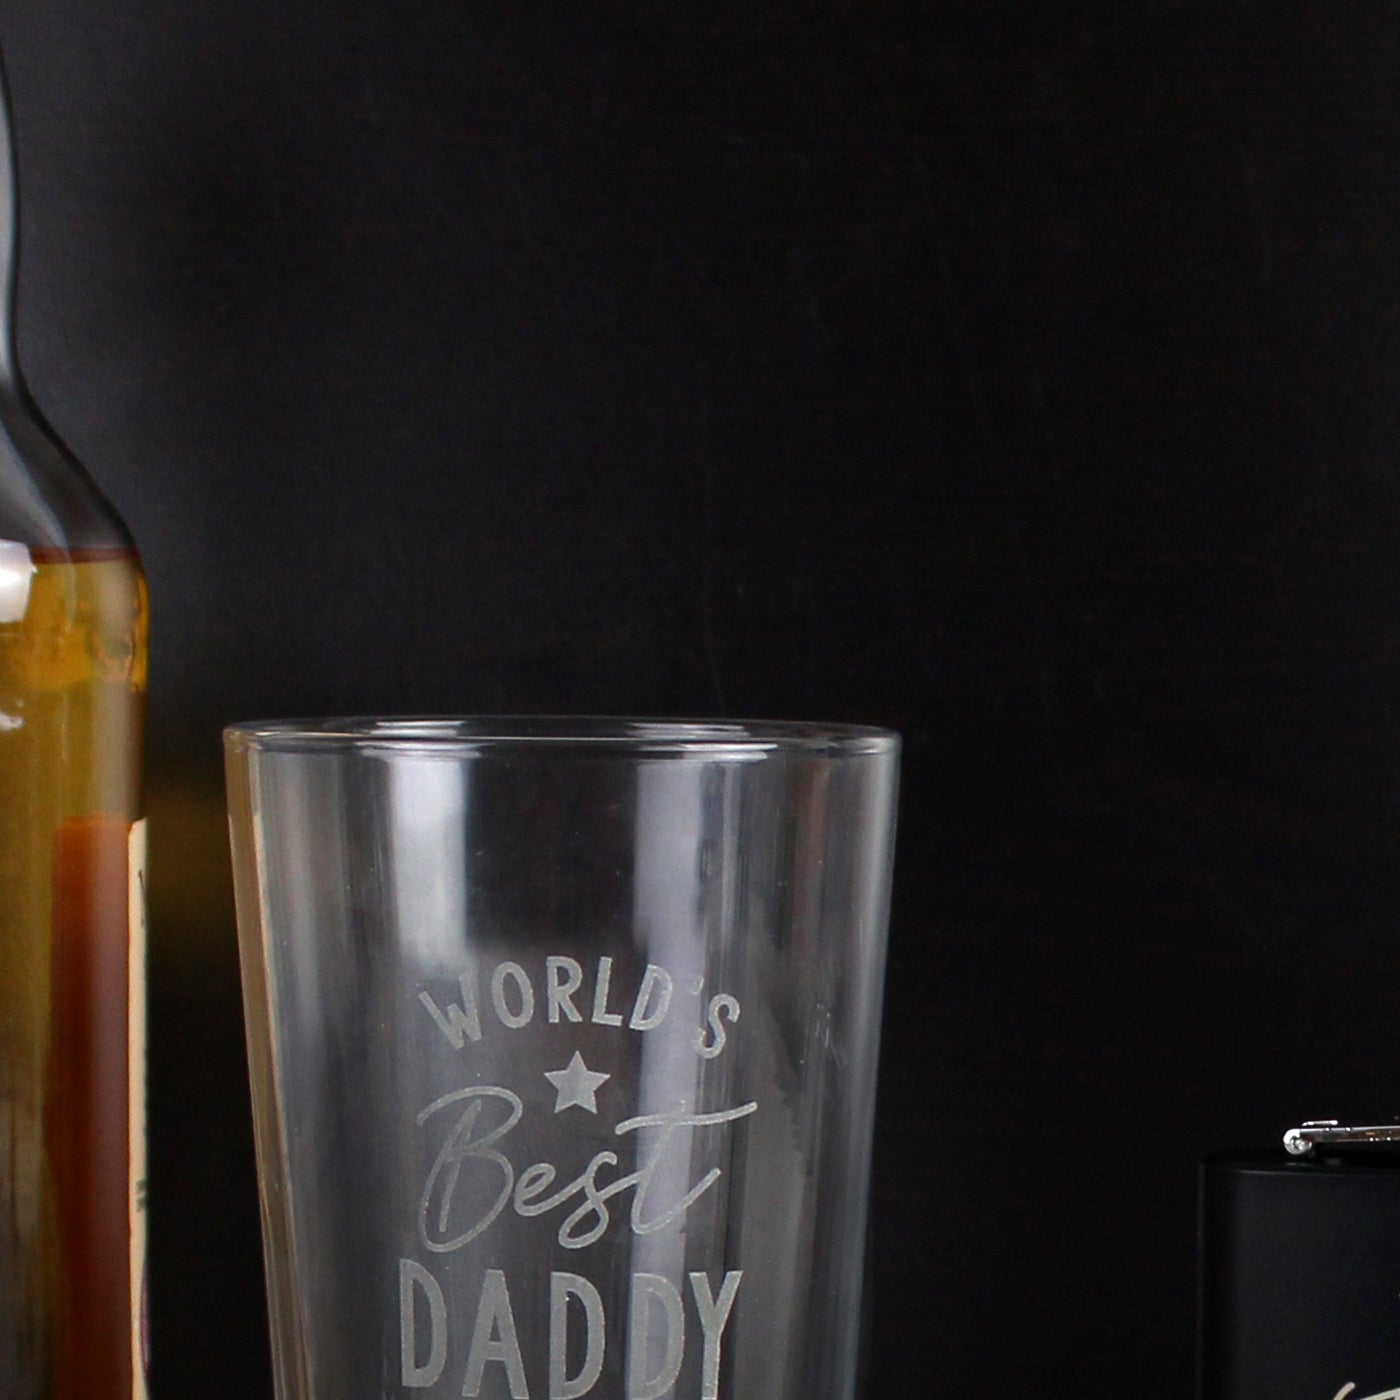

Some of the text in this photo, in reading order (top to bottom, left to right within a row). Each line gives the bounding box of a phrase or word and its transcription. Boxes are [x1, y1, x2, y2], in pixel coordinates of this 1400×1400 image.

[418, 956, 741, 1060] WORLD'S
[416, 1085, 758, 1253] Best
[399, 1258, 743, 1400] DADDY
